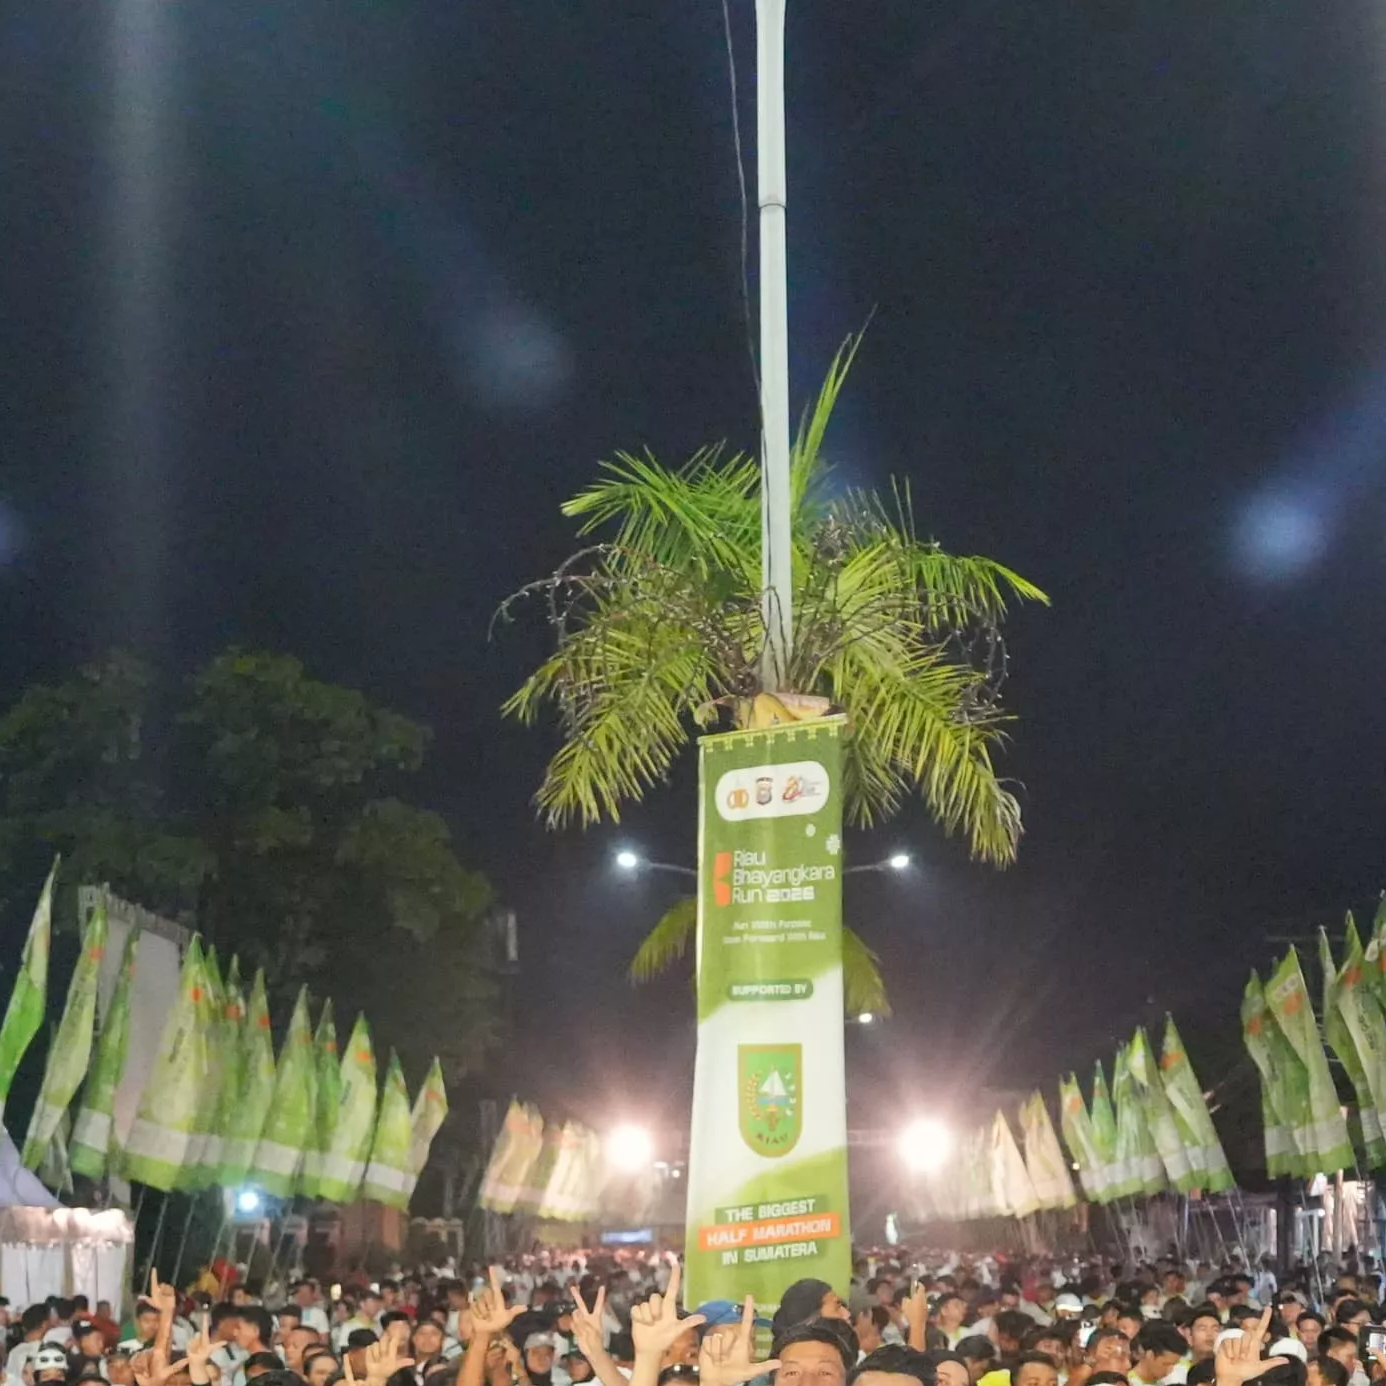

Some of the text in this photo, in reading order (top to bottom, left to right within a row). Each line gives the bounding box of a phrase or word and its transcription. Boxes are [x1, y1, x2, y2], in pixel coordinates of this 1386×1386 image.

[733, 864, 835, 889] Bhayangkara
[732, 983, 792, 996] SUPPORTED
[725, 1198, 816, 1224] THE BIGGEST
[707, 1219, 832, 1246] HALF MARATHON
[722, 1242, 818, 1266] IN SUMATERA
